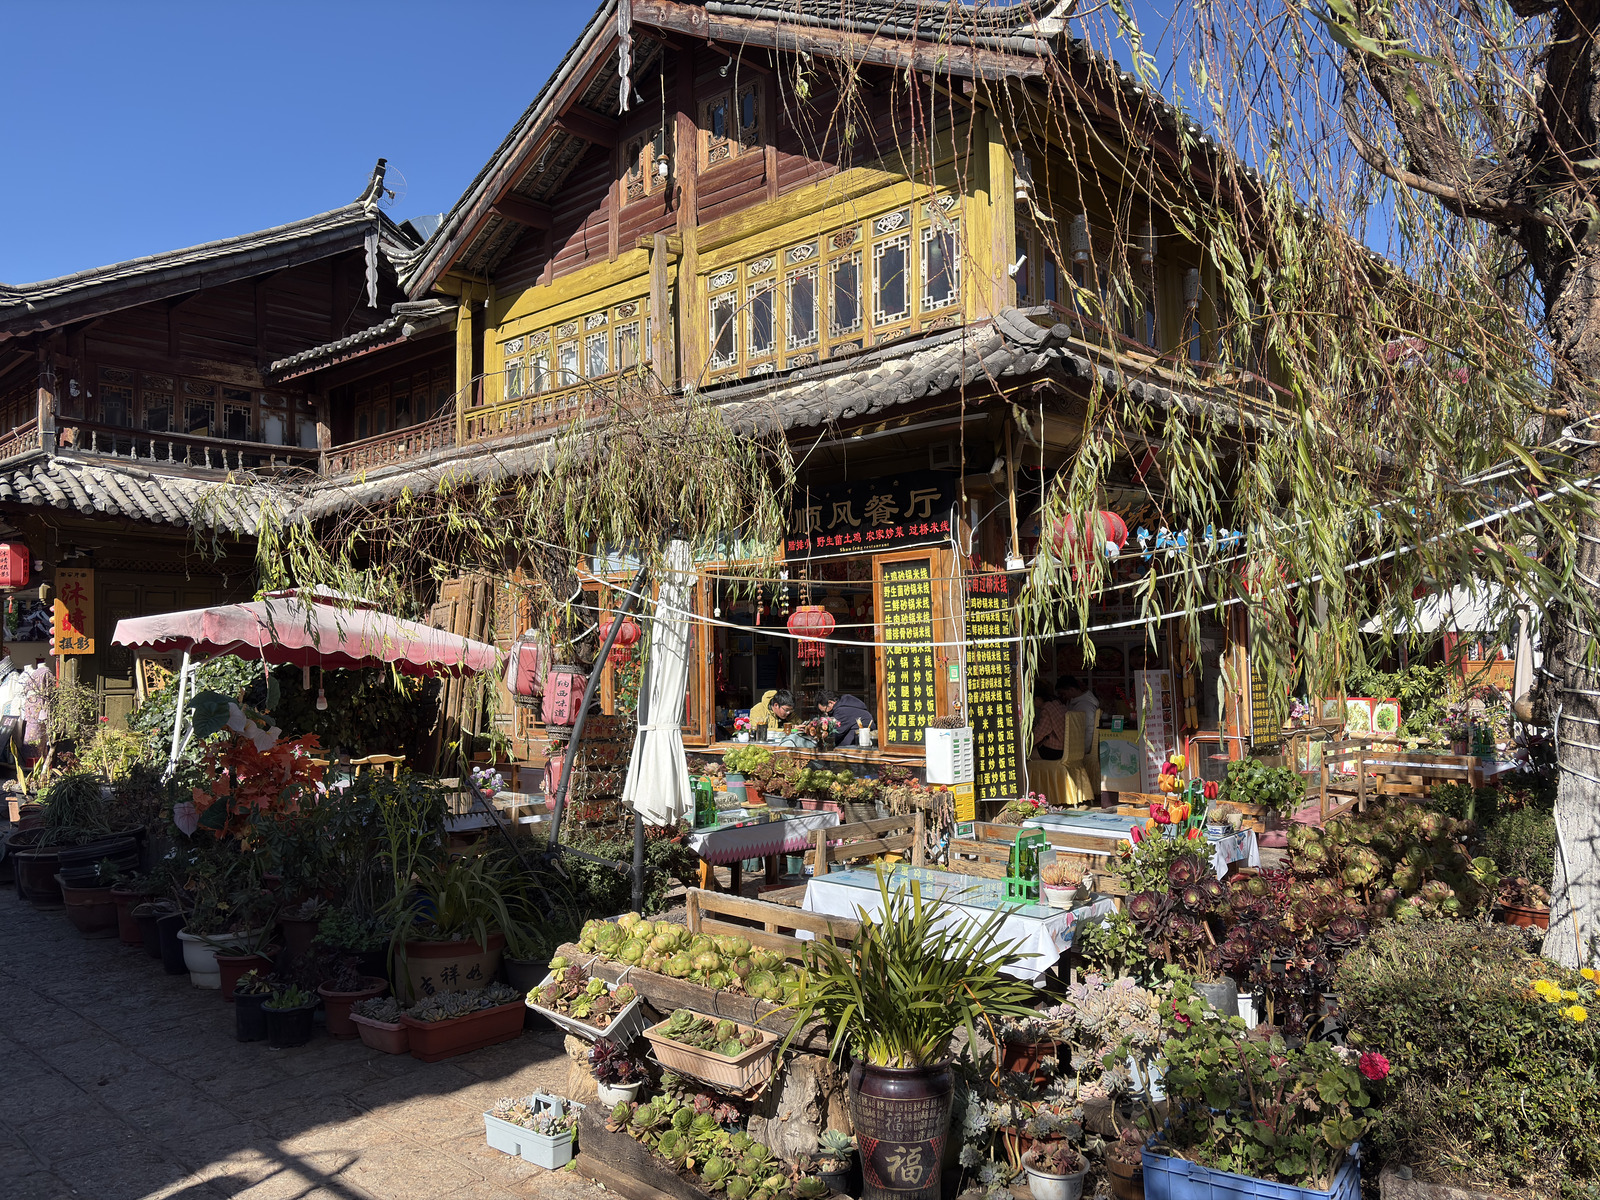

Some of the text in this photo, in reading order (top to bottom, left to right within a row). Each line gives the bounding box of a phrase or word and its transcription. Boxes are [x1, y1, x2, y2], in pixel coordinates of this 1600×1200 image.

[793, 487, 942, 534] 顺风餐厅
[816, 532, 862, 547] 野生菌土鸡
[866, 526, 905, 542] 农家炒菜
[909, 520, 950, 536] 过桥米线
[884, 568, 929, 584] 土鸡砂锅米线
[884, 582, 930, 598] 野生菌砂锅米线
[884, 597, 930, 612] 三鲜砂锅米线
[885, 612, 930, 626] 牛肉砂锅米线
[885, 626, 931, 640] 腊排骨砂锅米线
[59, 637, 90, 651] 摄影
[886, 641, 931, 654] 火腿砂锅米线
[887, 655, 932, 669] 小锅米线
[887, 670, 933, 683] 扬州炒饭
[888, 685, 934, 698] 火腿炒饭
[555, 680, 570, 718] 纳西味道
[888, 700, 934, 712] 鸡蛋炒饭
[888, 714, 935, 727] 火腿蛋炒饭
[888, 729, 923, 742] 纳西炒
[885, 1112, 904, 1132] 福
[885, 1146, 923, 1184] 福
